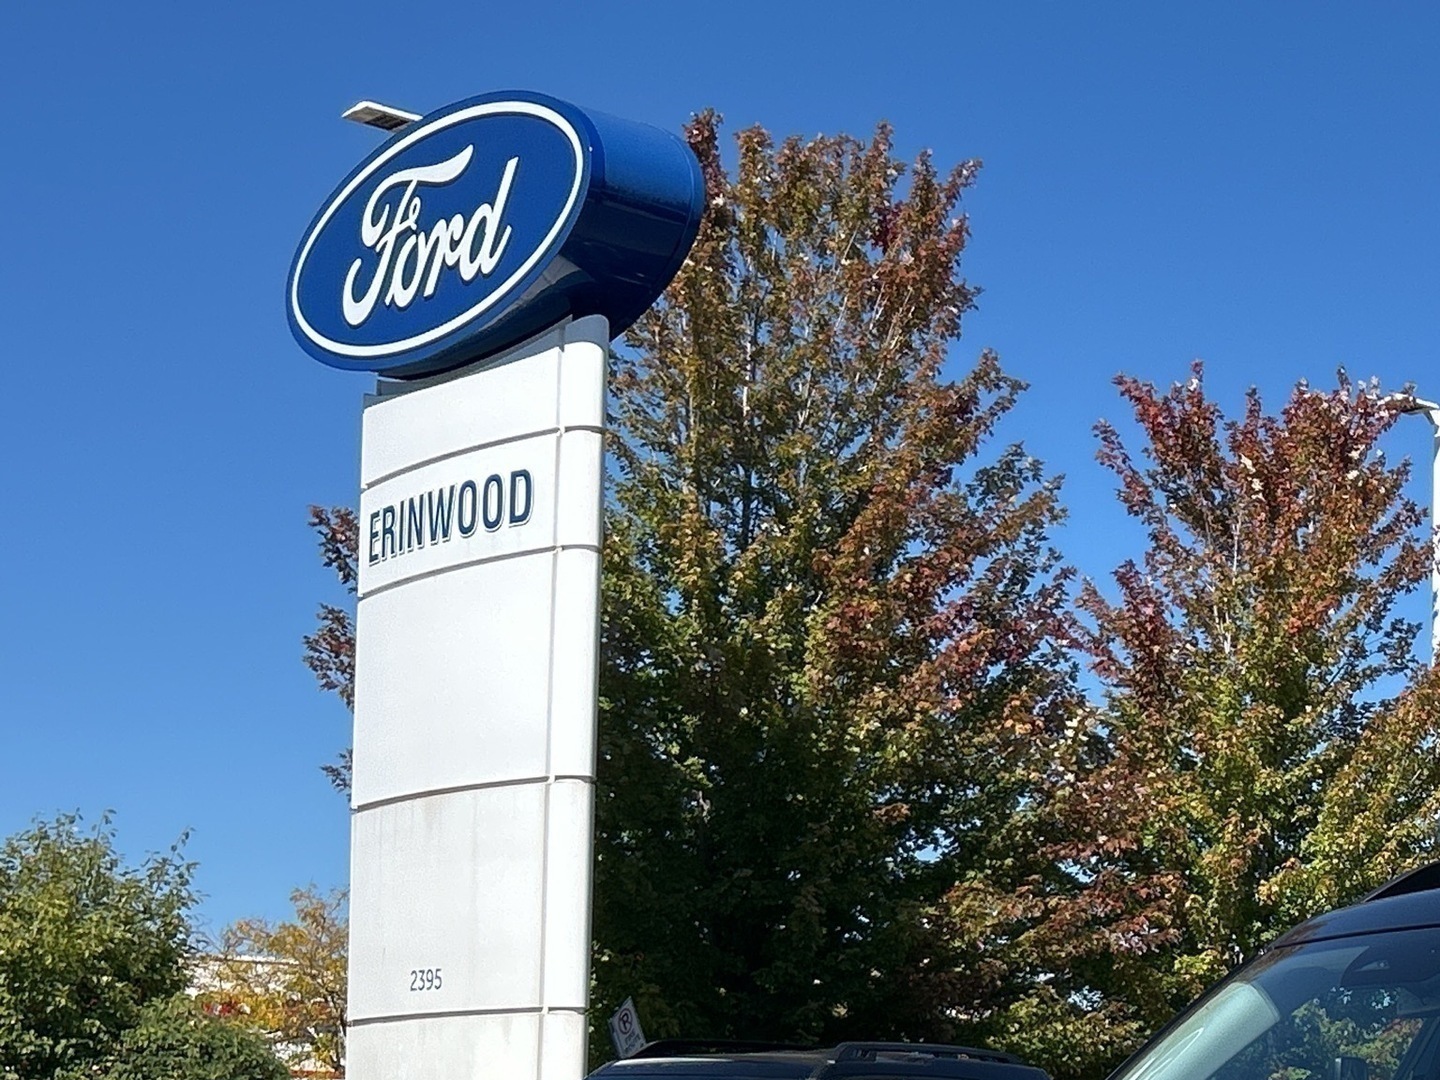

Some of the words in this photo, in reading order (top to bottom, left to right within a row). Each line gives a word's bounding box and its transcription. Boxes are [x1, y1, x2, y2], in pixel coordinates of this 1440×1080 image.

[342, 144, 519, 326] Ford
[368, 469, 532, 564] ERINWOOD
[410, 968, 443, 991] 2395
